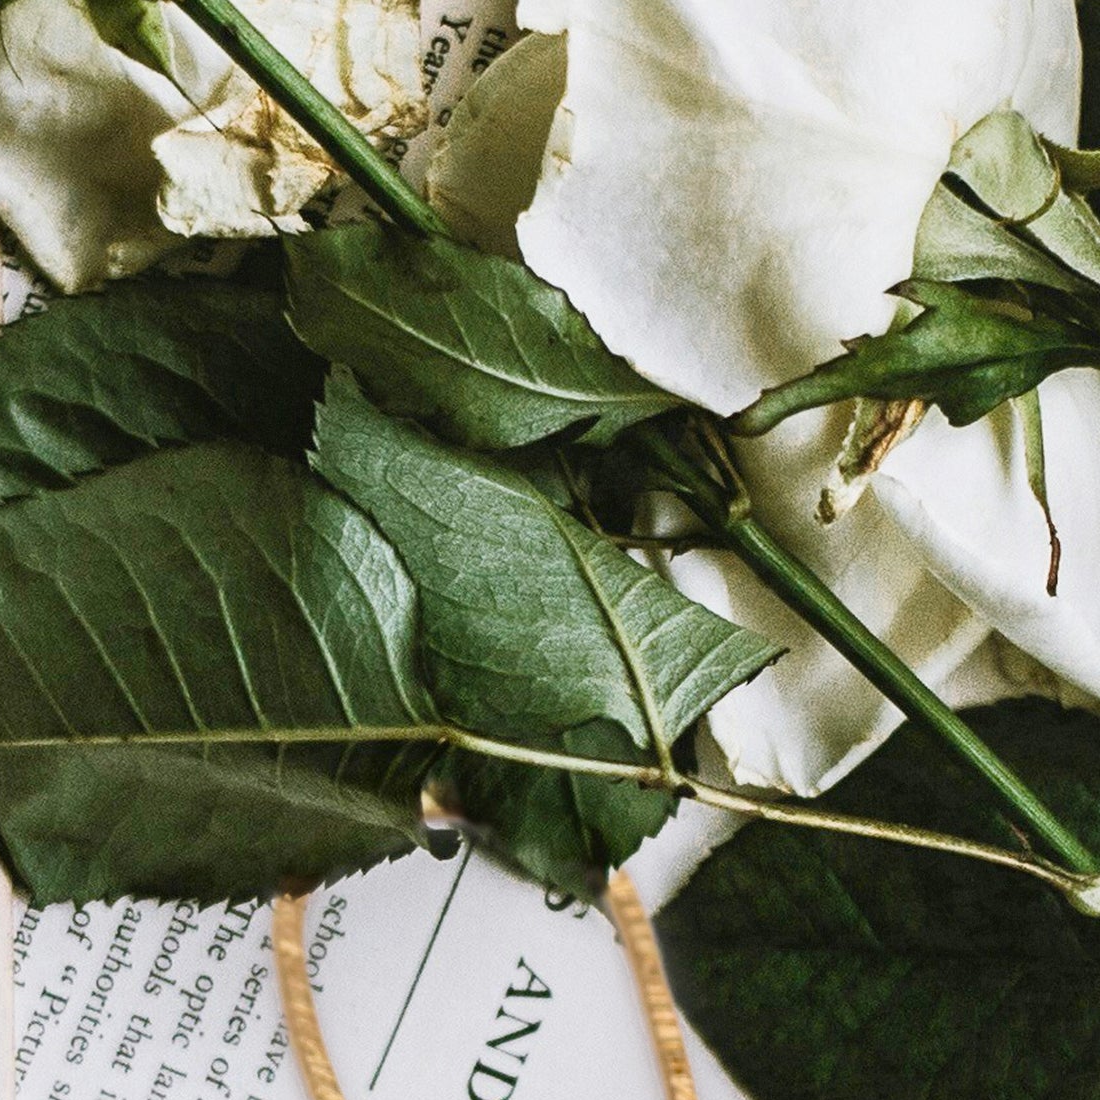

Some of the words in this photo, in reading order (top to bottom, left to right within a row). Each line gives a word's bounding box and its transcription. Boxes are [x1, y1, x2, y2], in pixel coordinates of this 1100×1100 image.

[66, 906, 93, 951] of
[206, 897, 260, 962] The
[65, 908, 142, 1065] authorities
[171, 974, 214, 1049] optic
[222, 963, 268, 1046] series
[111, 1014, 153, 1074] that
[205, 1057, 231, 1099] of
